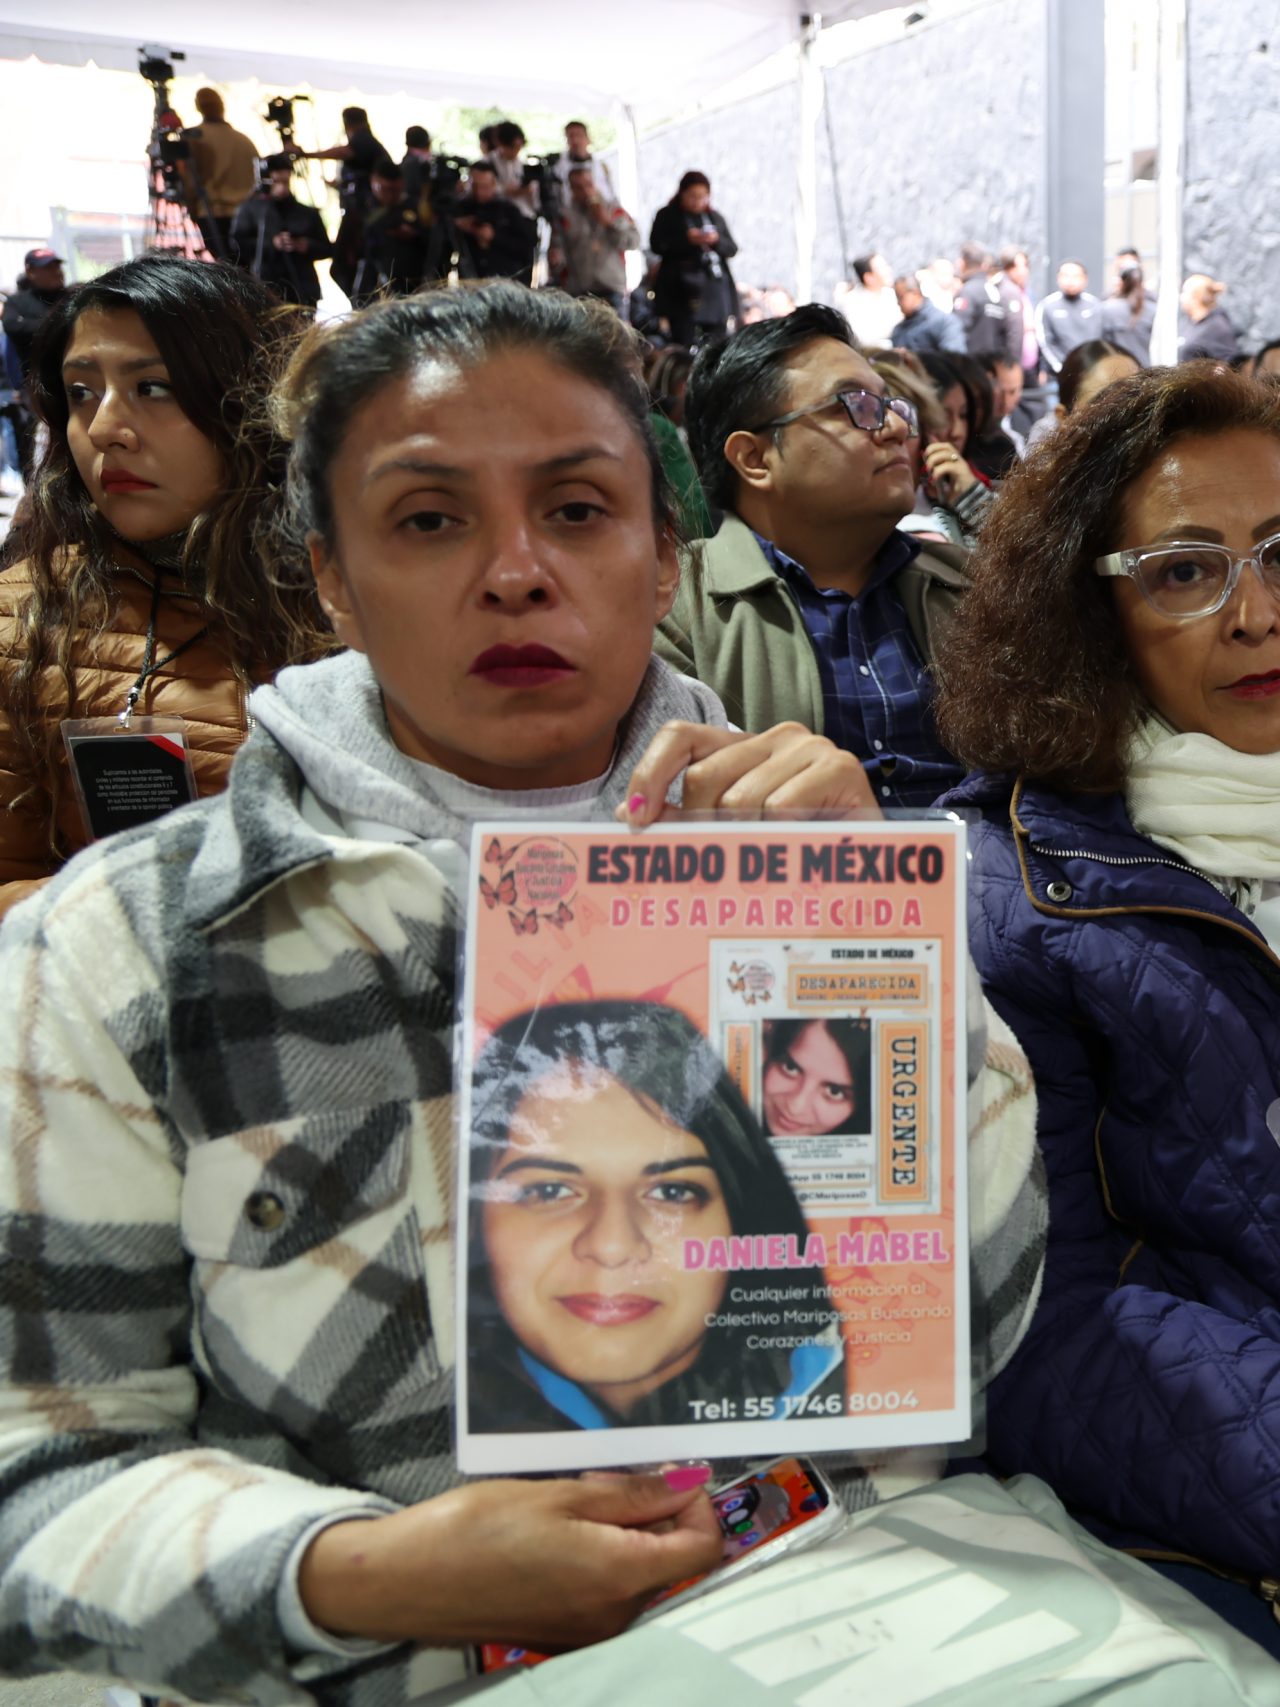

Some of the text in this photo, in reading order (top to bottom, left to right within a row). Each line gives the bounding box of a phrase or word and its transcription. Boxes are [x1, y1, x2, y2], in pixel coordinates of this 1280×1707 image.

[587, 837, 945, 885] ESTADO DE MÉXICO
[611, 897, 923, 927] DESAPARECIDA
[799, 976, 917, 990] DESAPARECIDA
[891, 1036, 917, 1185] URGENTE
[683, 1232, 948, 1270] DANIELA MABEL
[730, 1280, 926, 1303] Cualquier información al
[704, 1305, 951, 1327] Colectivo Mariposas Buscando
[746, 1334, 834, 1349] Corazones
[850, 1331, 910, 1344] Justicia
[689, 1390, 919, 1420] Tel: 55 1746 8004
